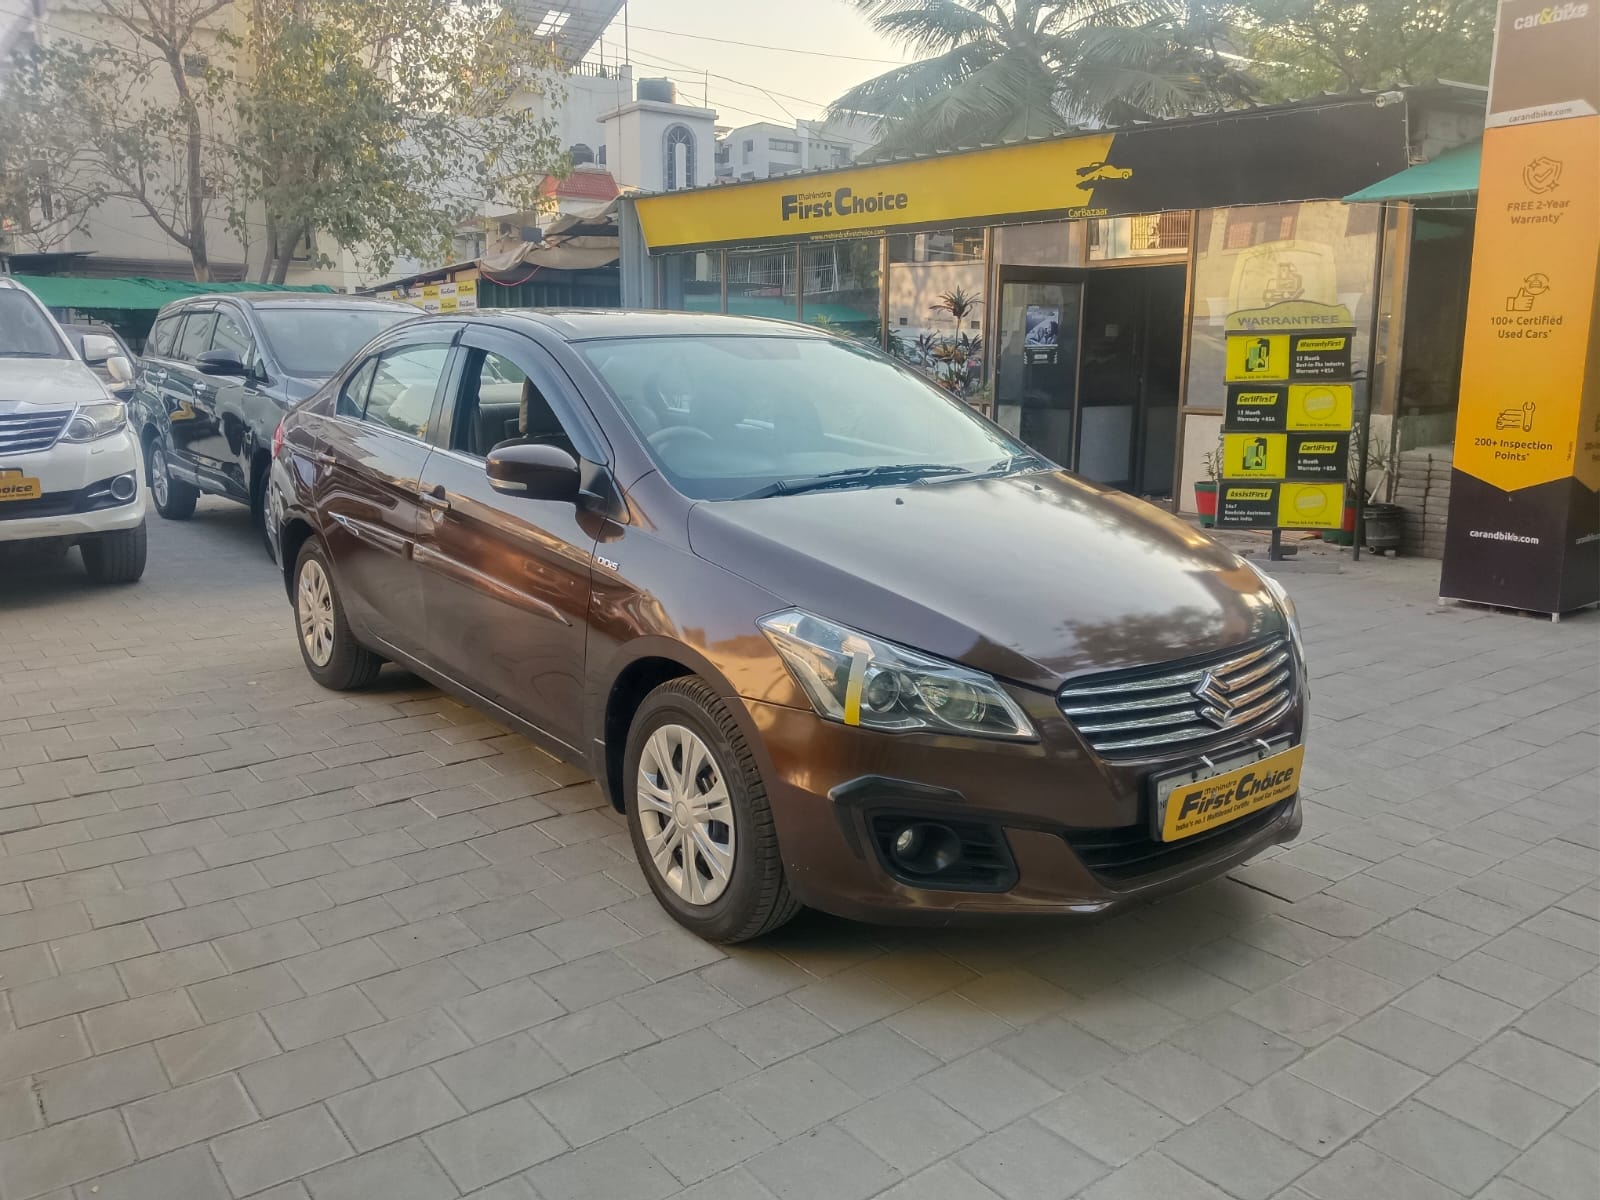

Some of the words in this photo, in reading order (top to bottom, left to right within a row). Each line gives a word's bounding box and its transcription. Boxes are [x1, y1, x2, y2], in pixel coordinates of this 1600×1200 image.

[1507, 202, 1534, 211] FREE
[1536, 200, 1570, 210] 2-Year
[1068, 208, 1108, 218] CarBazaar
[1238, 315, 1340, 326] WARRANTREE
[1490, 316, 1514, 326] 100+
[1516, 315, 1563, 326] Certified
[1498, 329, 1523, 339] Used
[1474, 437, 1497, 447] 200+
[1500, 439, 1553, 451] Inspection
[1469, 530, 1540, 545] carandbike.com
